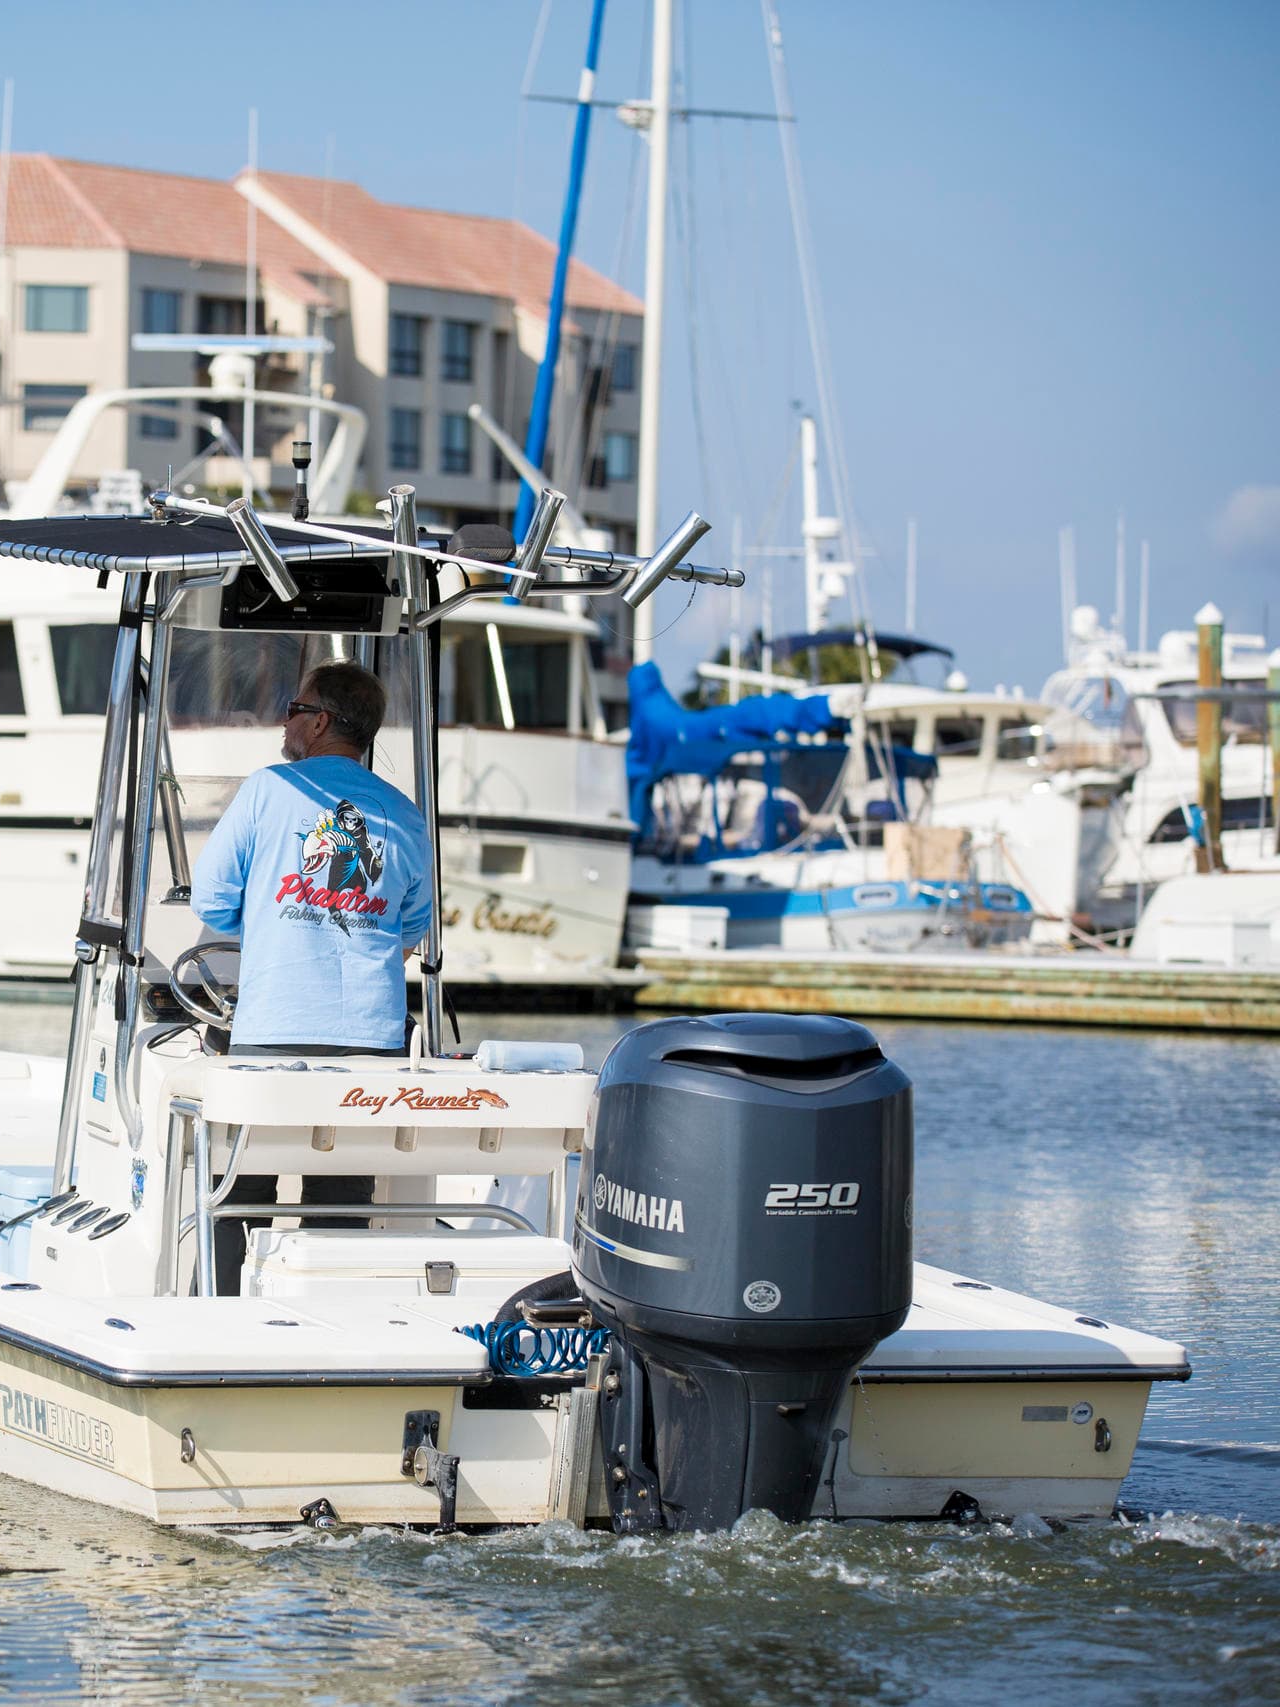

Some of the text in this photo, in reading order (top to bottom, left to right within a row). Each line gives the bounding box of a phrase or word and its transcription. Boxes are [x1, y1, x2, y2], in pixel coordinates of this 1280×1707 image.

[275, 873, 388, 916] Phantom
[279, 905, 326, 926] Fishing
[339, 1087, 482, 1116] Bay Runner
[607, 1180, 685, 1233] YAMAHA
[764, 1182, 860, 1208] 250
[835, 1208, 858, 1216] Timing
